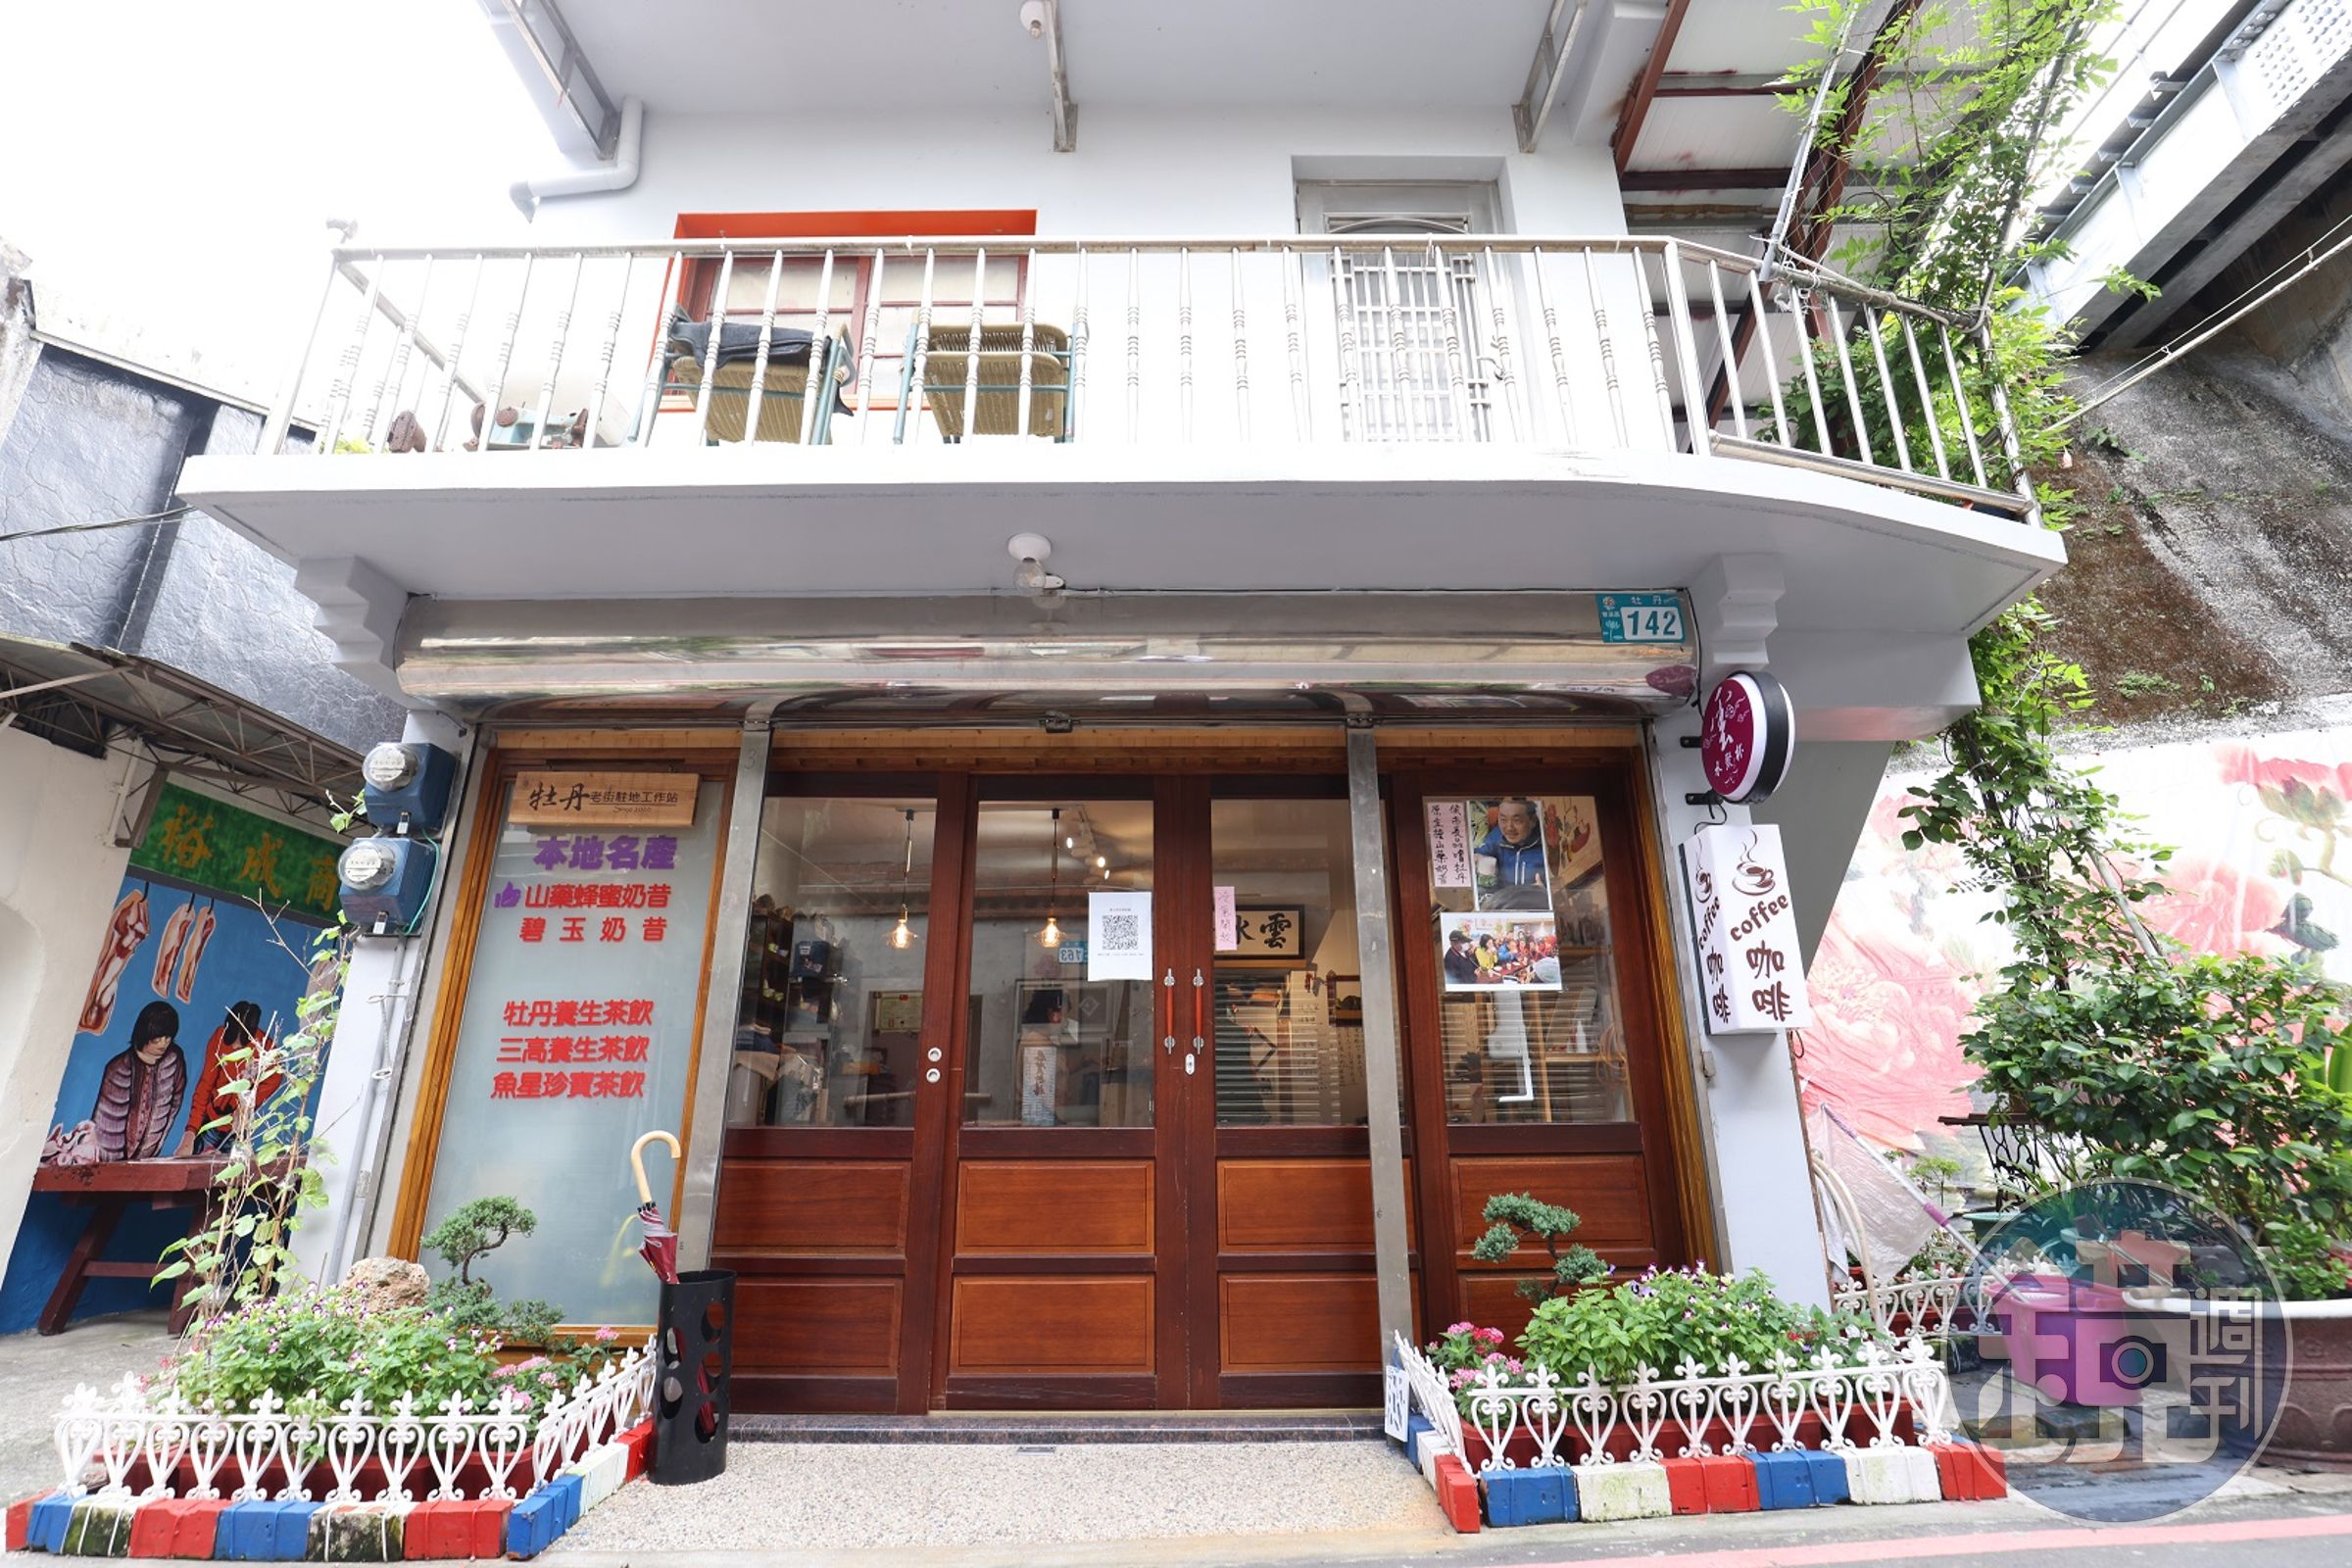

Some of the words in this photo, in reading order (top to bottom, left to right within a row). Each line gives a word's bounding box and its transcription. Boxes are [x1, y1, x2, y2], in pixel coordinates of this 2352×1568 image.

[1627, 611, 1676, 636] 142
[529, 781, 589, 811] 牡丹
[533, 835, 677, 870] 本地名產
[524, 883, 671, 908] 山藥蜂蜜奶昔
[519, 916, 667, 942] 碧玉奶昔
[1698, 896, 1721, 950] coffee
[1730, 894, 1788, 942] coffee
[1706, 945, 1732, 1024] 咖啡
[1745, 939, 1793, 1022] 咖啡
[504, 999, 655, 1027] 牡丹養生茶飲
[496, 1035, 650, 1063] 三高養生茶飲
